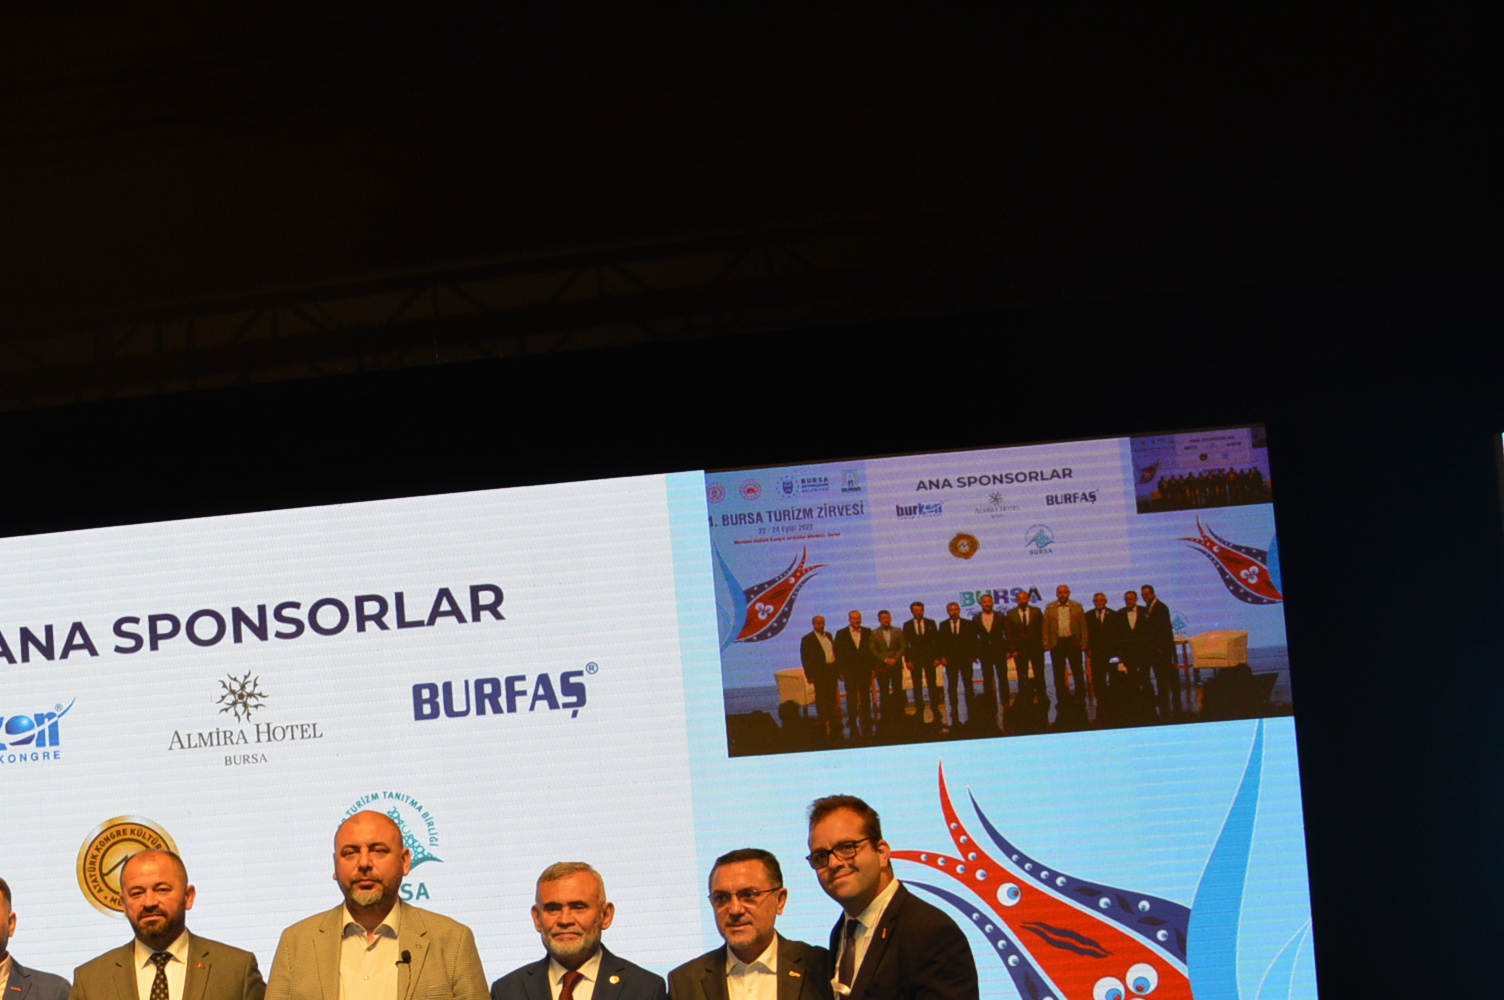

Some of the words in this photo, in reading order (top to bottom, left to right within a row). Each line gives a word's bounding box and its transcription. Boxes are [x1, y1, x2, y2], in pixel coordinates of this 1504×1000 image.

[916, 479, 953, 492] ANA
[956, 468, 1073, 488] SPONSORLAR
[1046, 491, 1097, 505] BURFAŞ
[722, 512, 763, 527] BURSA
[766, 506, 814, 523] TURİZM
[817, 500, 864, 517] ZİRVESİ
[112, 583, 507, 655] SPONSORLAR
[412, 669, 588, 722] BURFAŞ
[168, 727, 250, 751] ALMİRA
[254, 722, 324, 744] HOTEL
[224, 753, 268, 766] BURSA
[345, 793, 380, 817] TURİZM
[382, 791, 423, 813] TANITMA
[421, 811, 439, 847] BİRLİĞİ
[95, 828, 128, 855] KONGRE
[130, 827, 163, 850] KÜLTÜR
[87, 852, 104, 894] ATATÜRK
